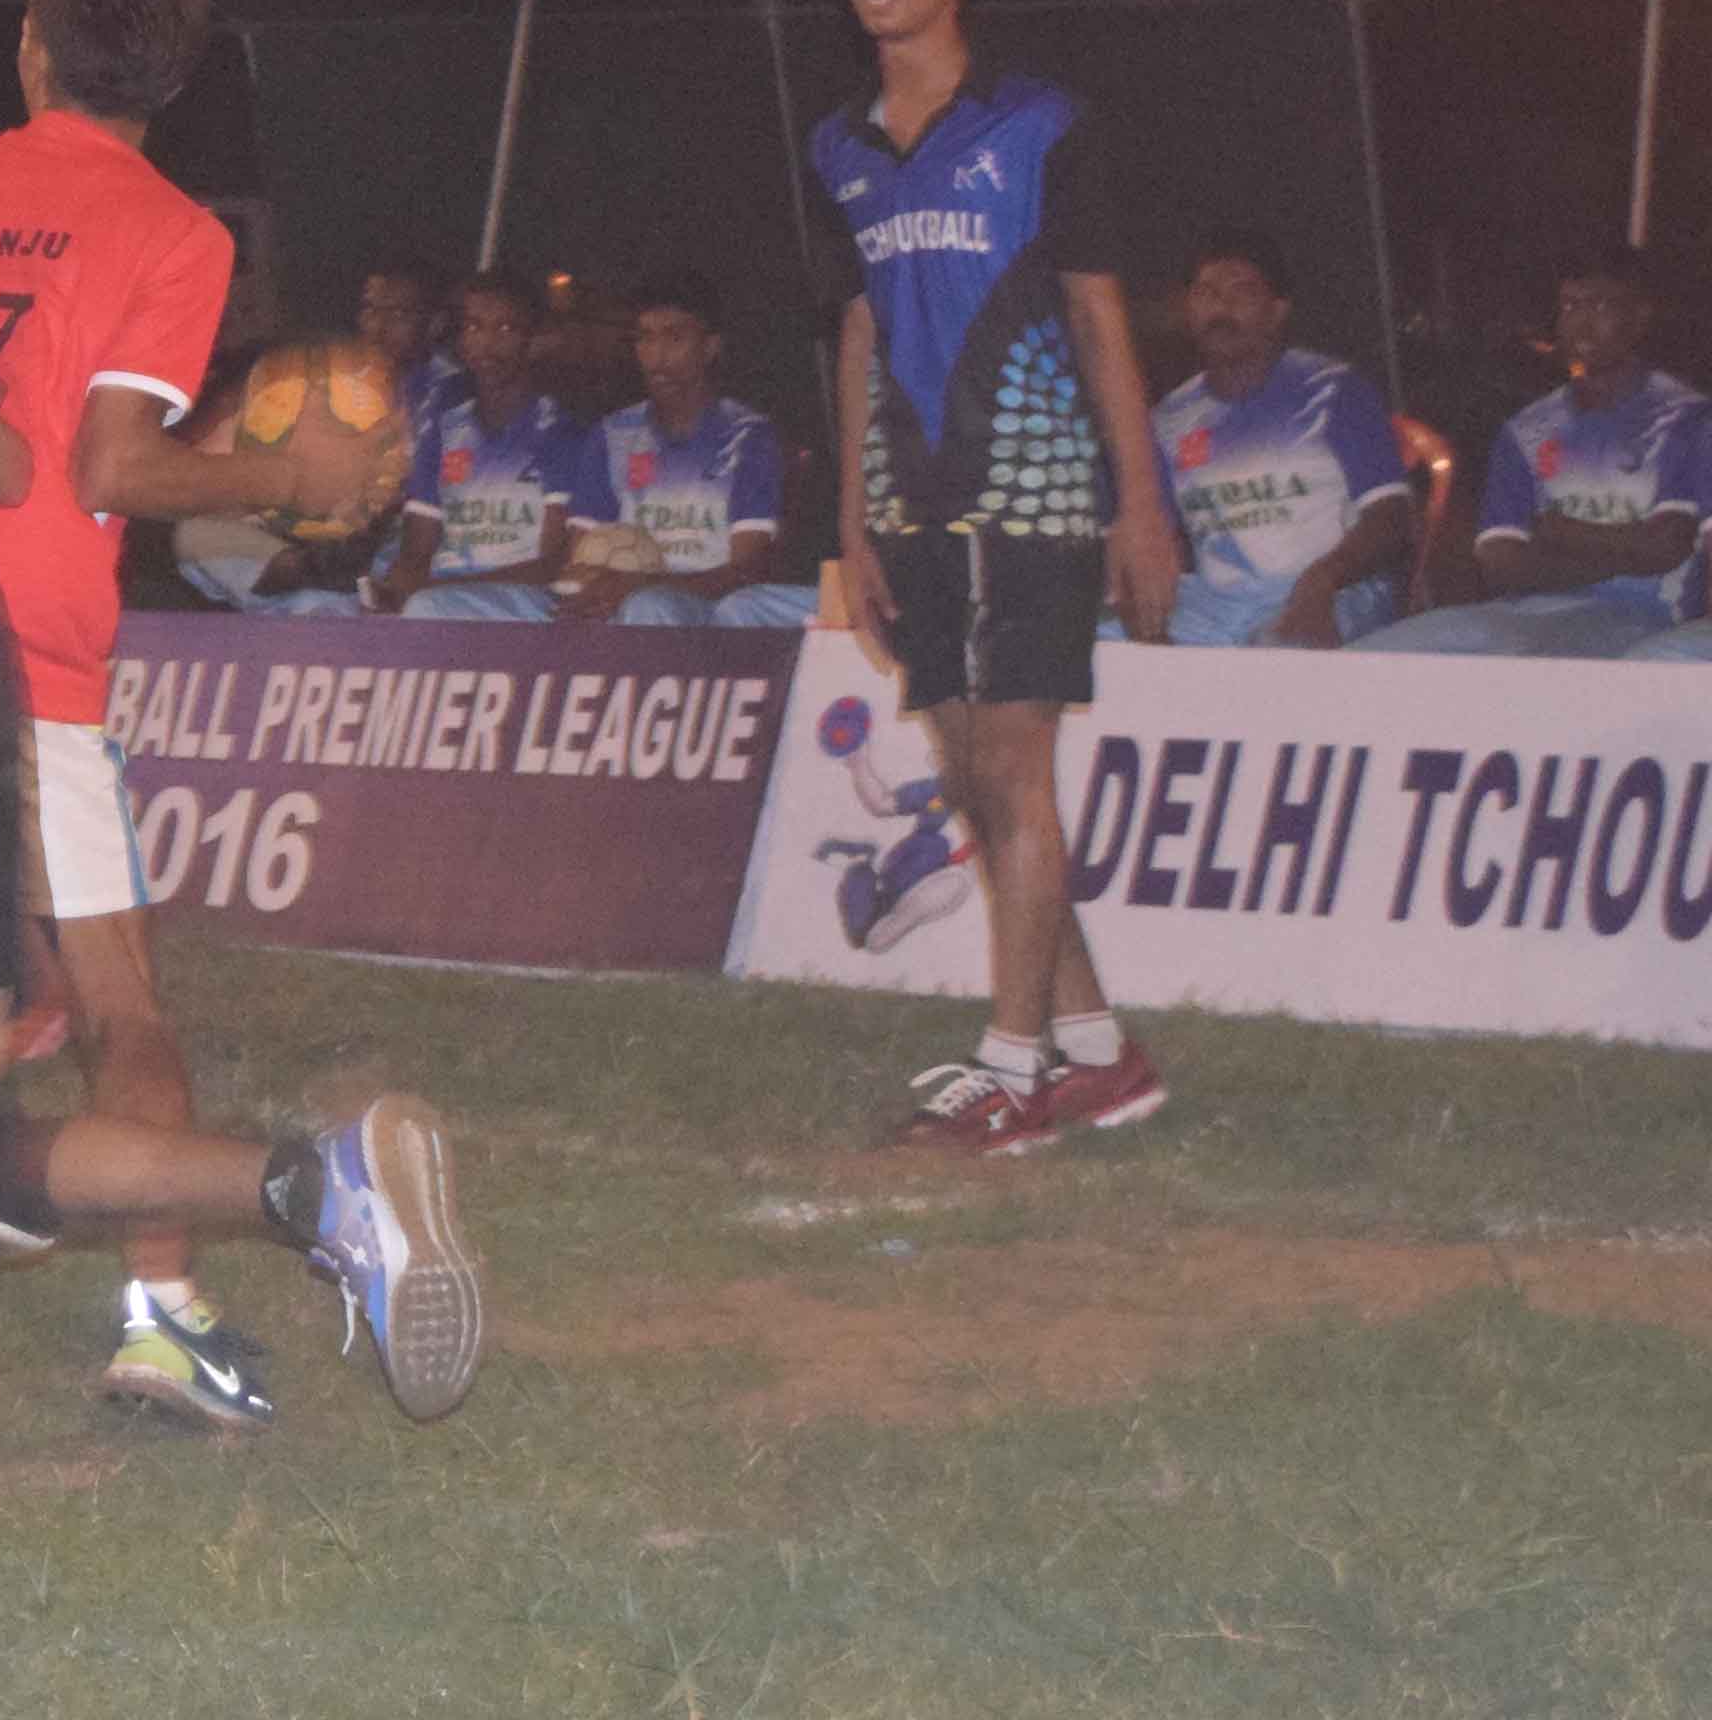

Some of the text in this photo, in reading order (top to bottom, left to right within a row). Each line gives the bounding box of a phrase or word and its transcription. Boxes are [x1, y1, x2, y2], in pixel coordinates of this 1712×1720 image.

[248, 664, 510, 774] PREMIER
[513, 673, 771, 782] LEAGUE
[129, 785, 322, 913] 016
[1070, 735, 1371, 918] DELHI
